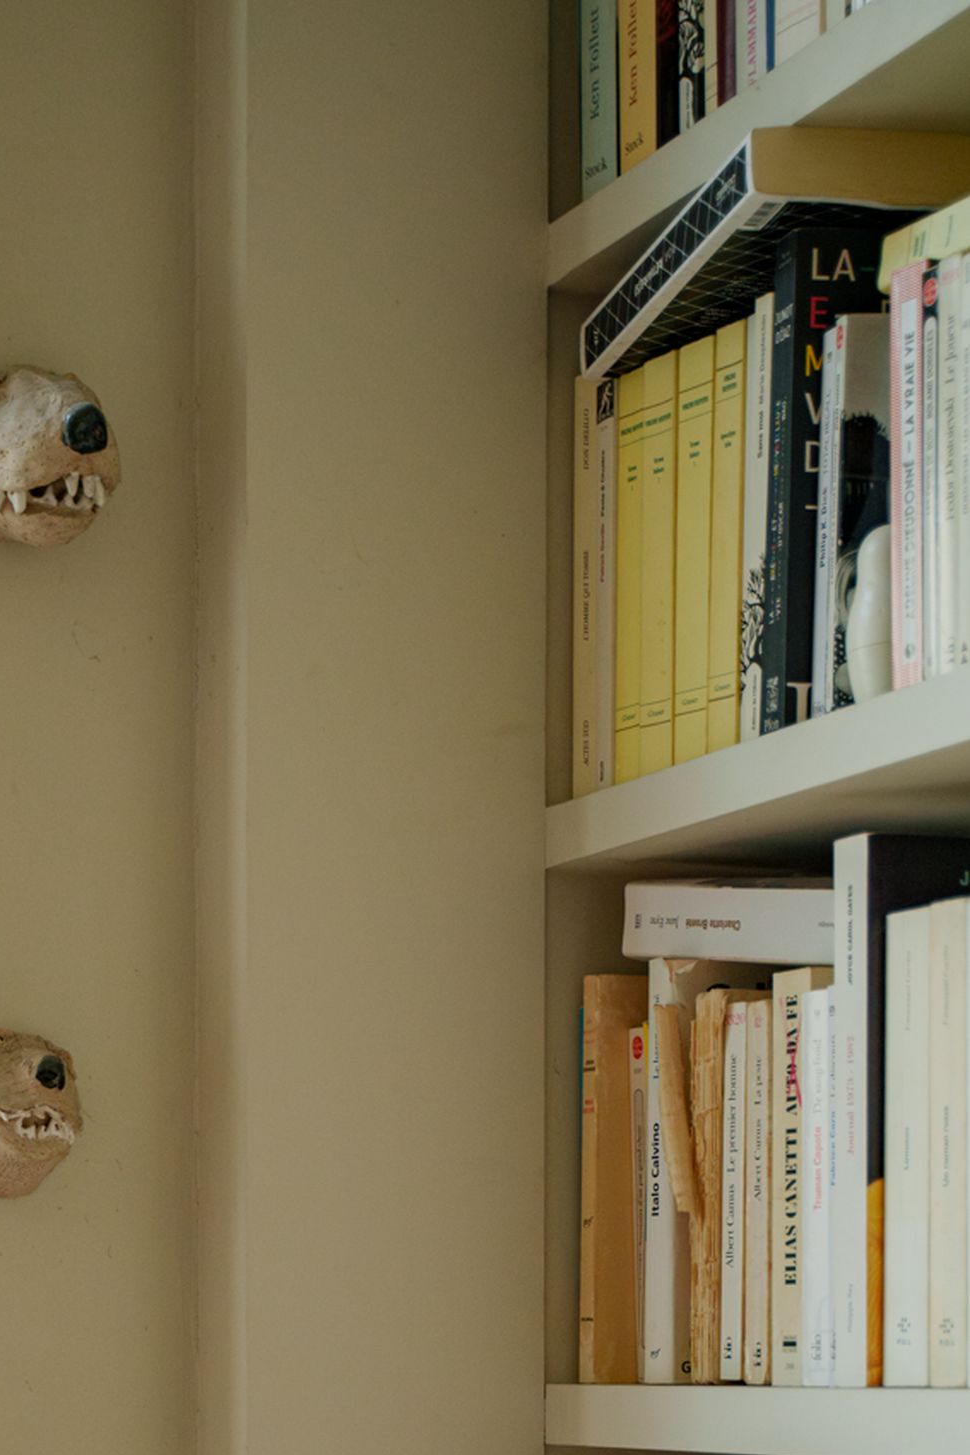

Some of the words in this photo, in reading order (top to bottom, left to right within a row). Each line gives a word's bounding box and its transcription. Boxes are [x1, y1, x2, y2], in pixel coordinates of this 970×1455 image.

[589, 7, 600, 73] Follett
[590, 80, 600, 121] Ken
[628, 65, 639, 107] Ken
[812, 247, 855, 281] LA
[903, 330, 915, 356] VIE
[903, 361, 915, 406] VRAIE
[904, 414, 915, 435] LA
[818, 533, 828, 569] Philip
[709, 918, 742, 931] Charlotte
[846, 919, 854, 952] CAROL
[846, 954, 854, 986] JOYCE
[727, 1053, 738, 1101] homme
[726, 1105, 738, 1153] premier
[846, 1110, 855, 1155] Journal
[650, 1122, 660, 1178] Calvino
[726, 1158, 736, 1173] Le
[784, 1126, 798, 1219] CANETTI
[813, 1167, 823, 1211] Truman
[650, 1182, 660, 1217] Italo
[725, 1183, 736, 1227] Camus
[724, 1229, 736, 1268] Albert
[784, 1224, 798, 1286] ELIAS
[810, 1333, 822, 1361] folio
